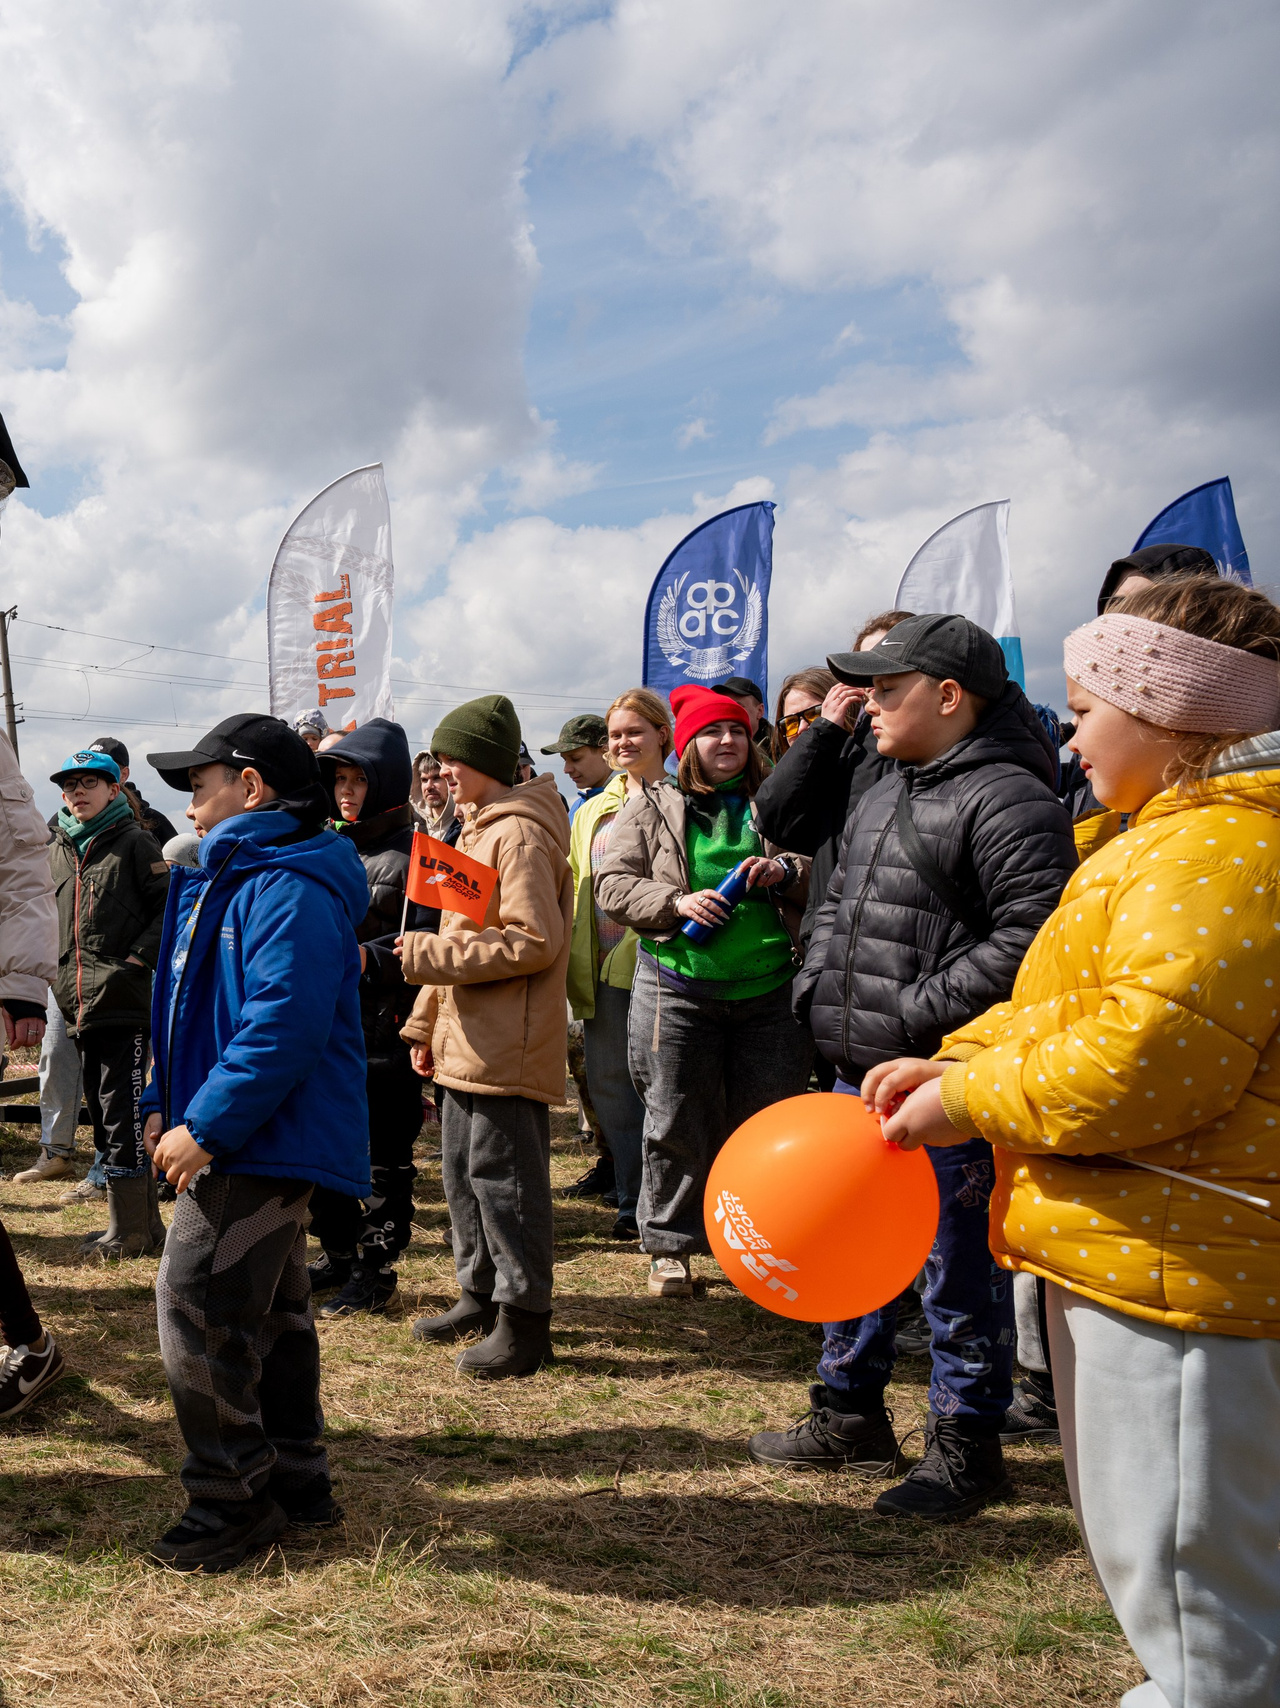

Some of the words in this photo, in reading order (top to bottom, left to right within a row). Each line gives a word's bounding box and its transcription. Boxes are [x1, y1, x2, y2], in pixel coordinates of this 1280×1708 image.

[313, 573, 357, 707] TRIAL
[419, 855, 482, 894] URAL
[441, 882, 475, 901] SPORT
[446, 877, 480, 899] MOTOR
[714, 1195, 799, 1302] URAL
[722, 1190, 761, 1250] MOTOR
[730, 1193, 772, 1250] SPORT
